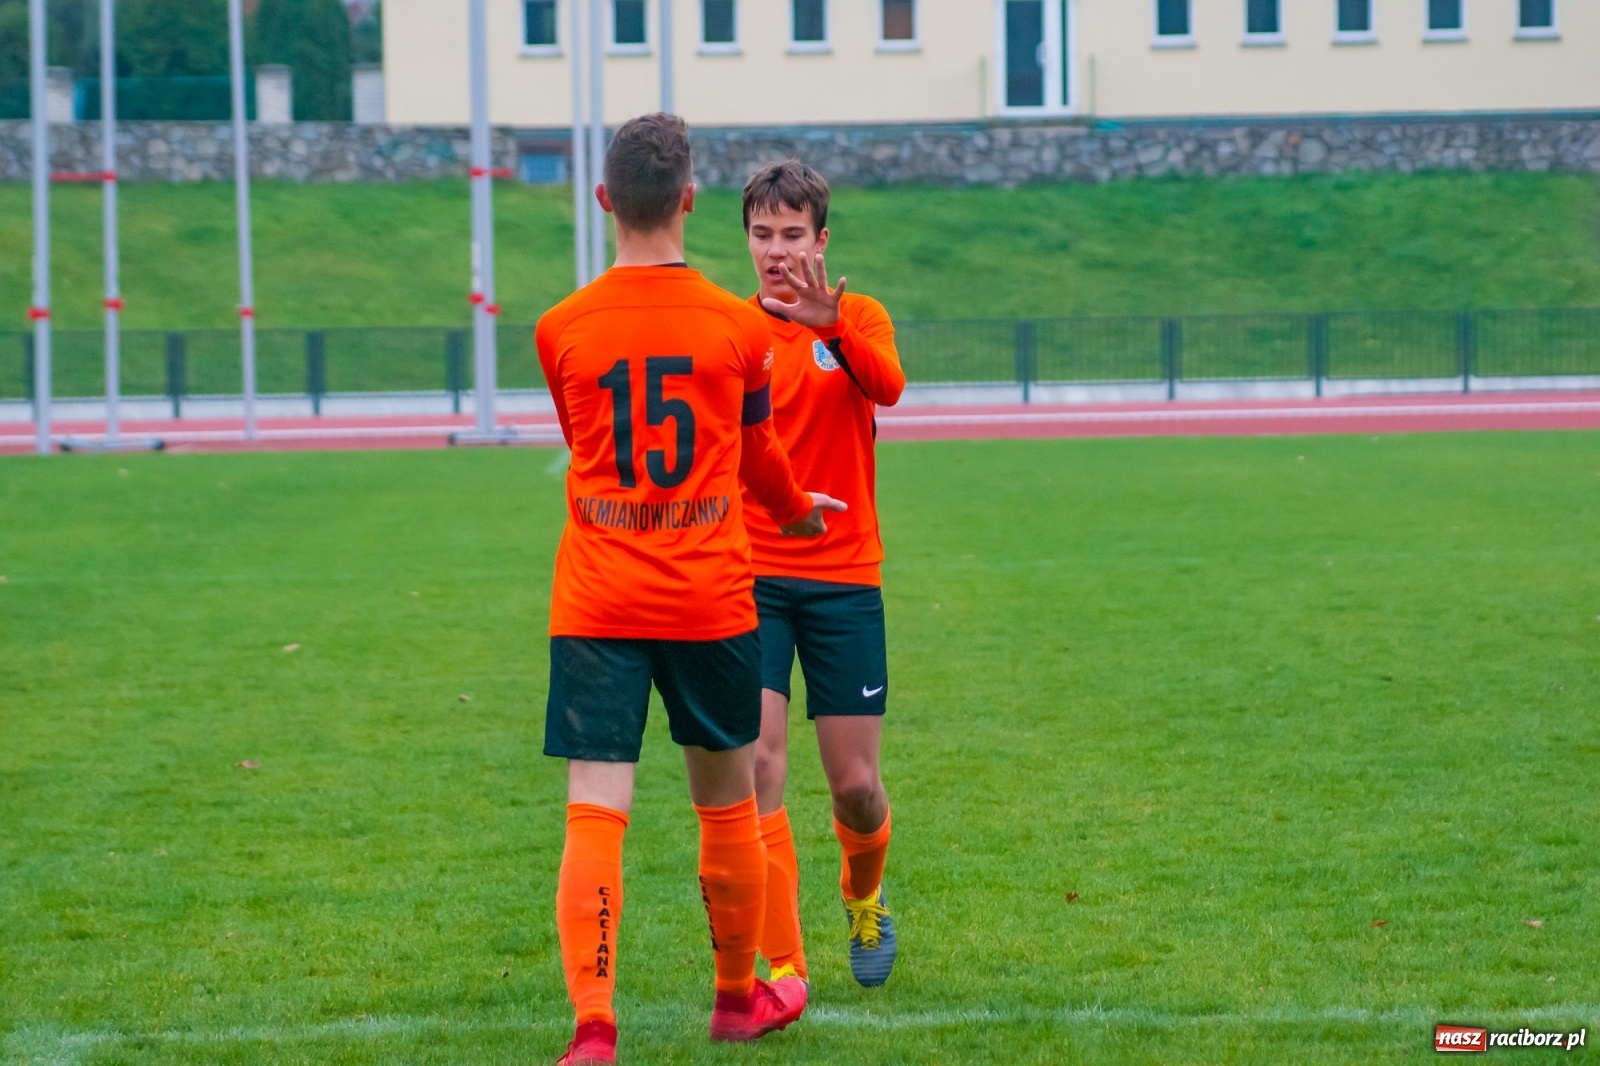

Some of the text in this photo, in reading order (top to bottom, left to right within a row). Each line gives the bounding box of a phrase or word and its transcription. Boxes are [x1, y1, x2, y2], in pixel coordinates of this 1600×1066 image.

[598, 356, 696, 489] 15
[576, 495, 730, 531] SIEMIANOWICZANKA
[596, 886, 611, 978] CIACIANA
